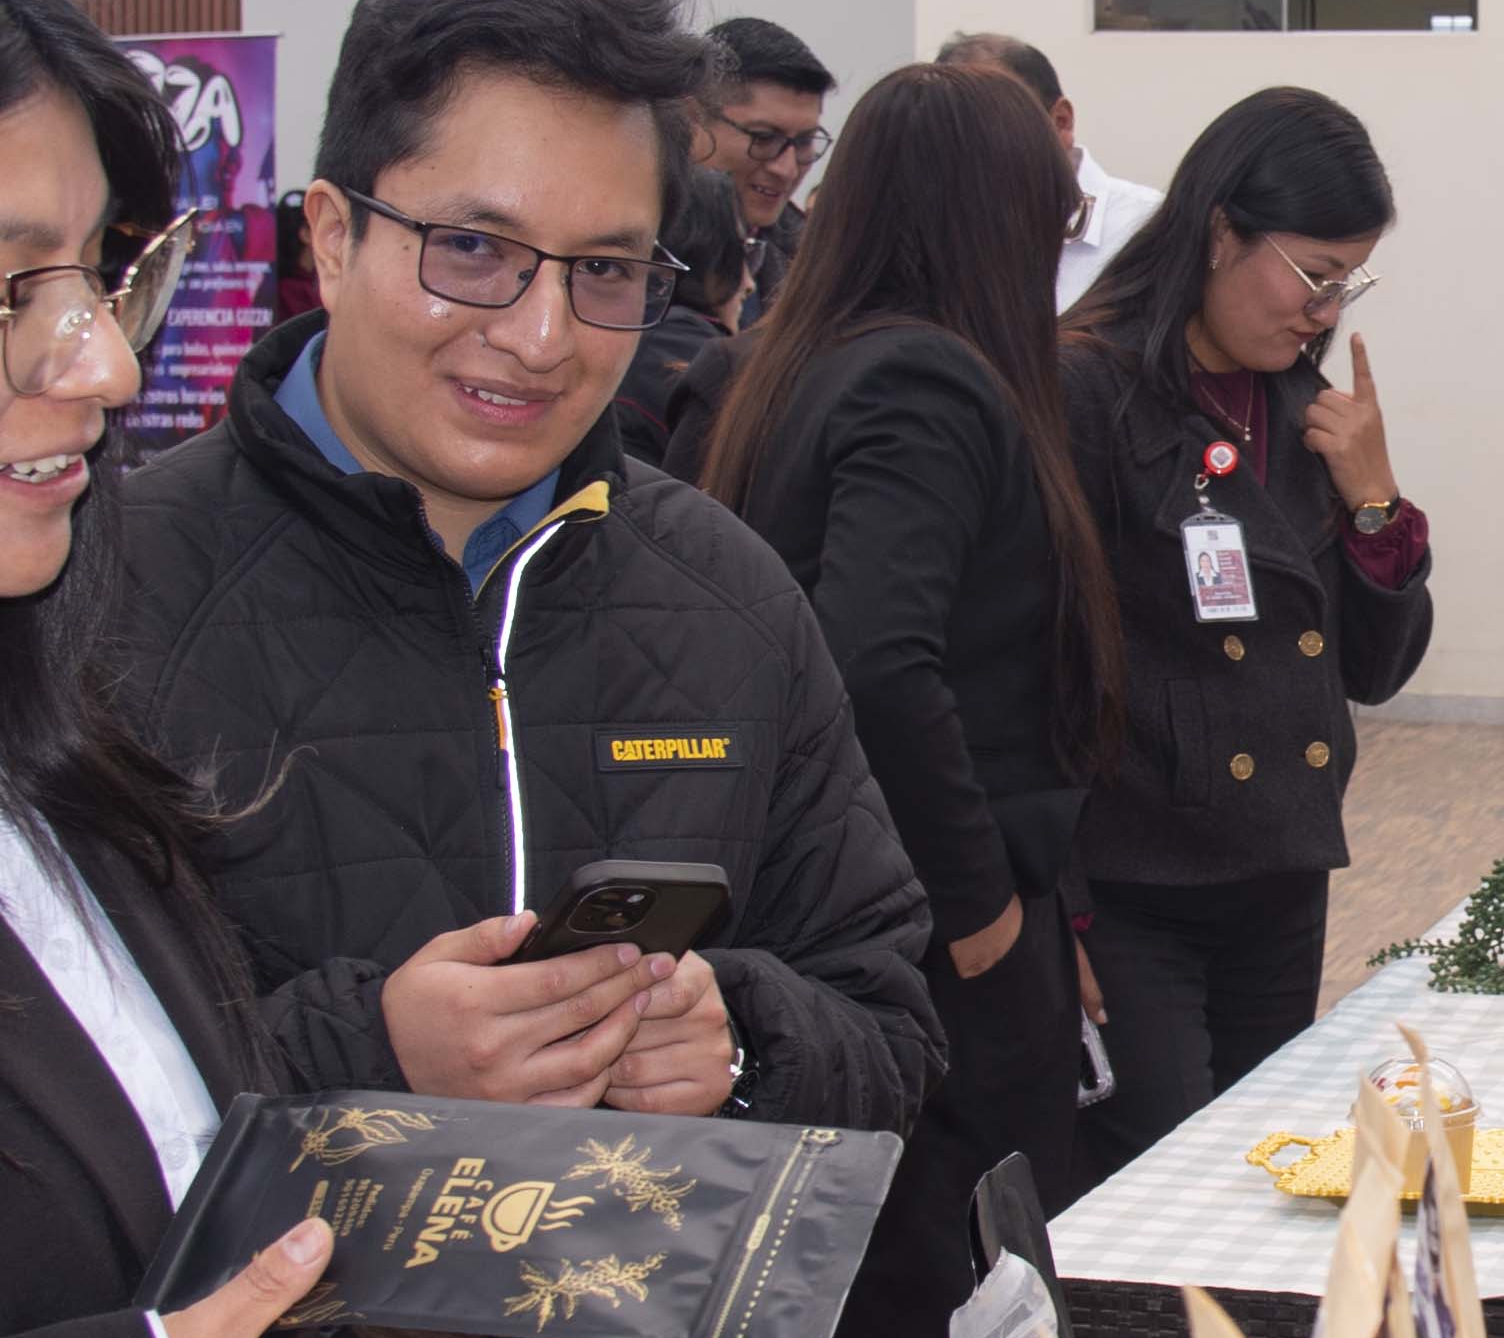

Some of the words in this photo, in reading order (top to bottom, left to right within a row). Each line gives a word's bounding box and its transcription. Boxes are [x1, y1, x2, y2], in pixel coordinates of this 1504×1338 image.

[611, 738, 727, 761] CATERPILLAR
[404, 1157, 486, 1269] ELENA
[450, 1179, 494, 1241] CAFÉ
